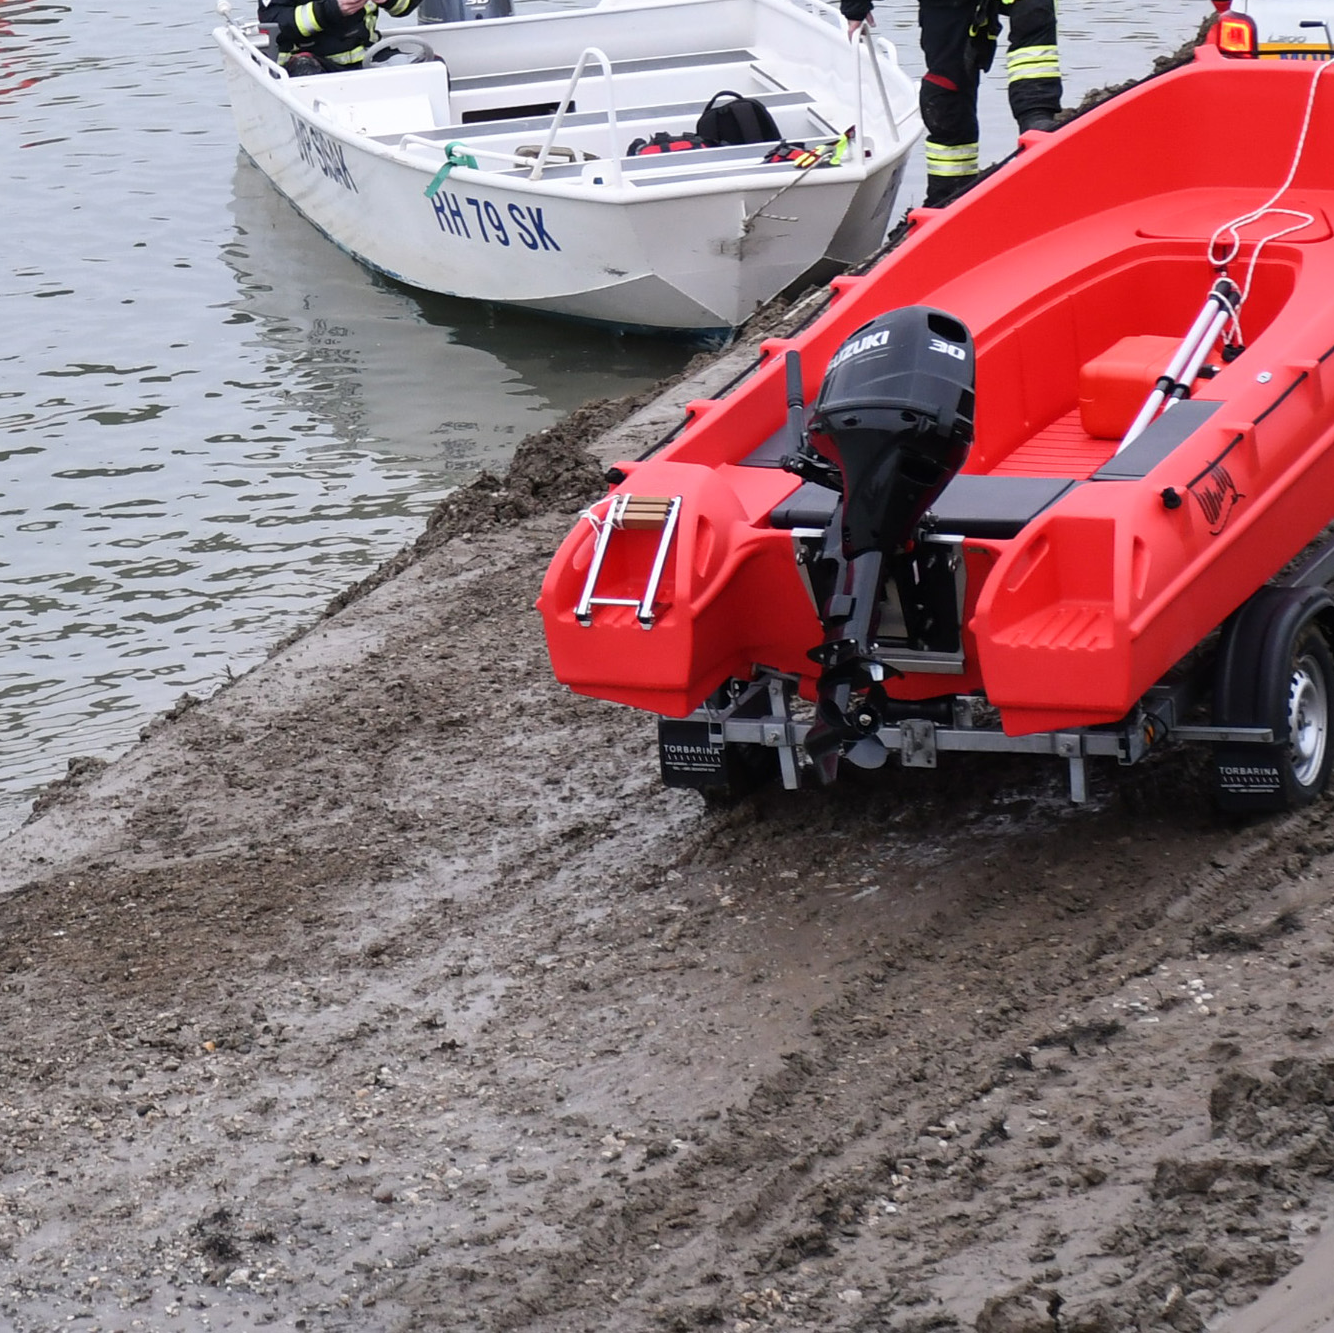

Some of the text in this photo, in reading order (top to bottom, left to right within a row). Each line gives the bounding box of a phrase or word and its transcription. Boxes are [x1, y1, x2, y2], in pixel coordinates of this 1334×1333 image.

[430, 190, 562, 252] RH 79 SK
[928, 338, 966, 361] 30
[663, 744, 720, 755] TORBARINA
[1219, 766, 1279, 776] TORBARINA
